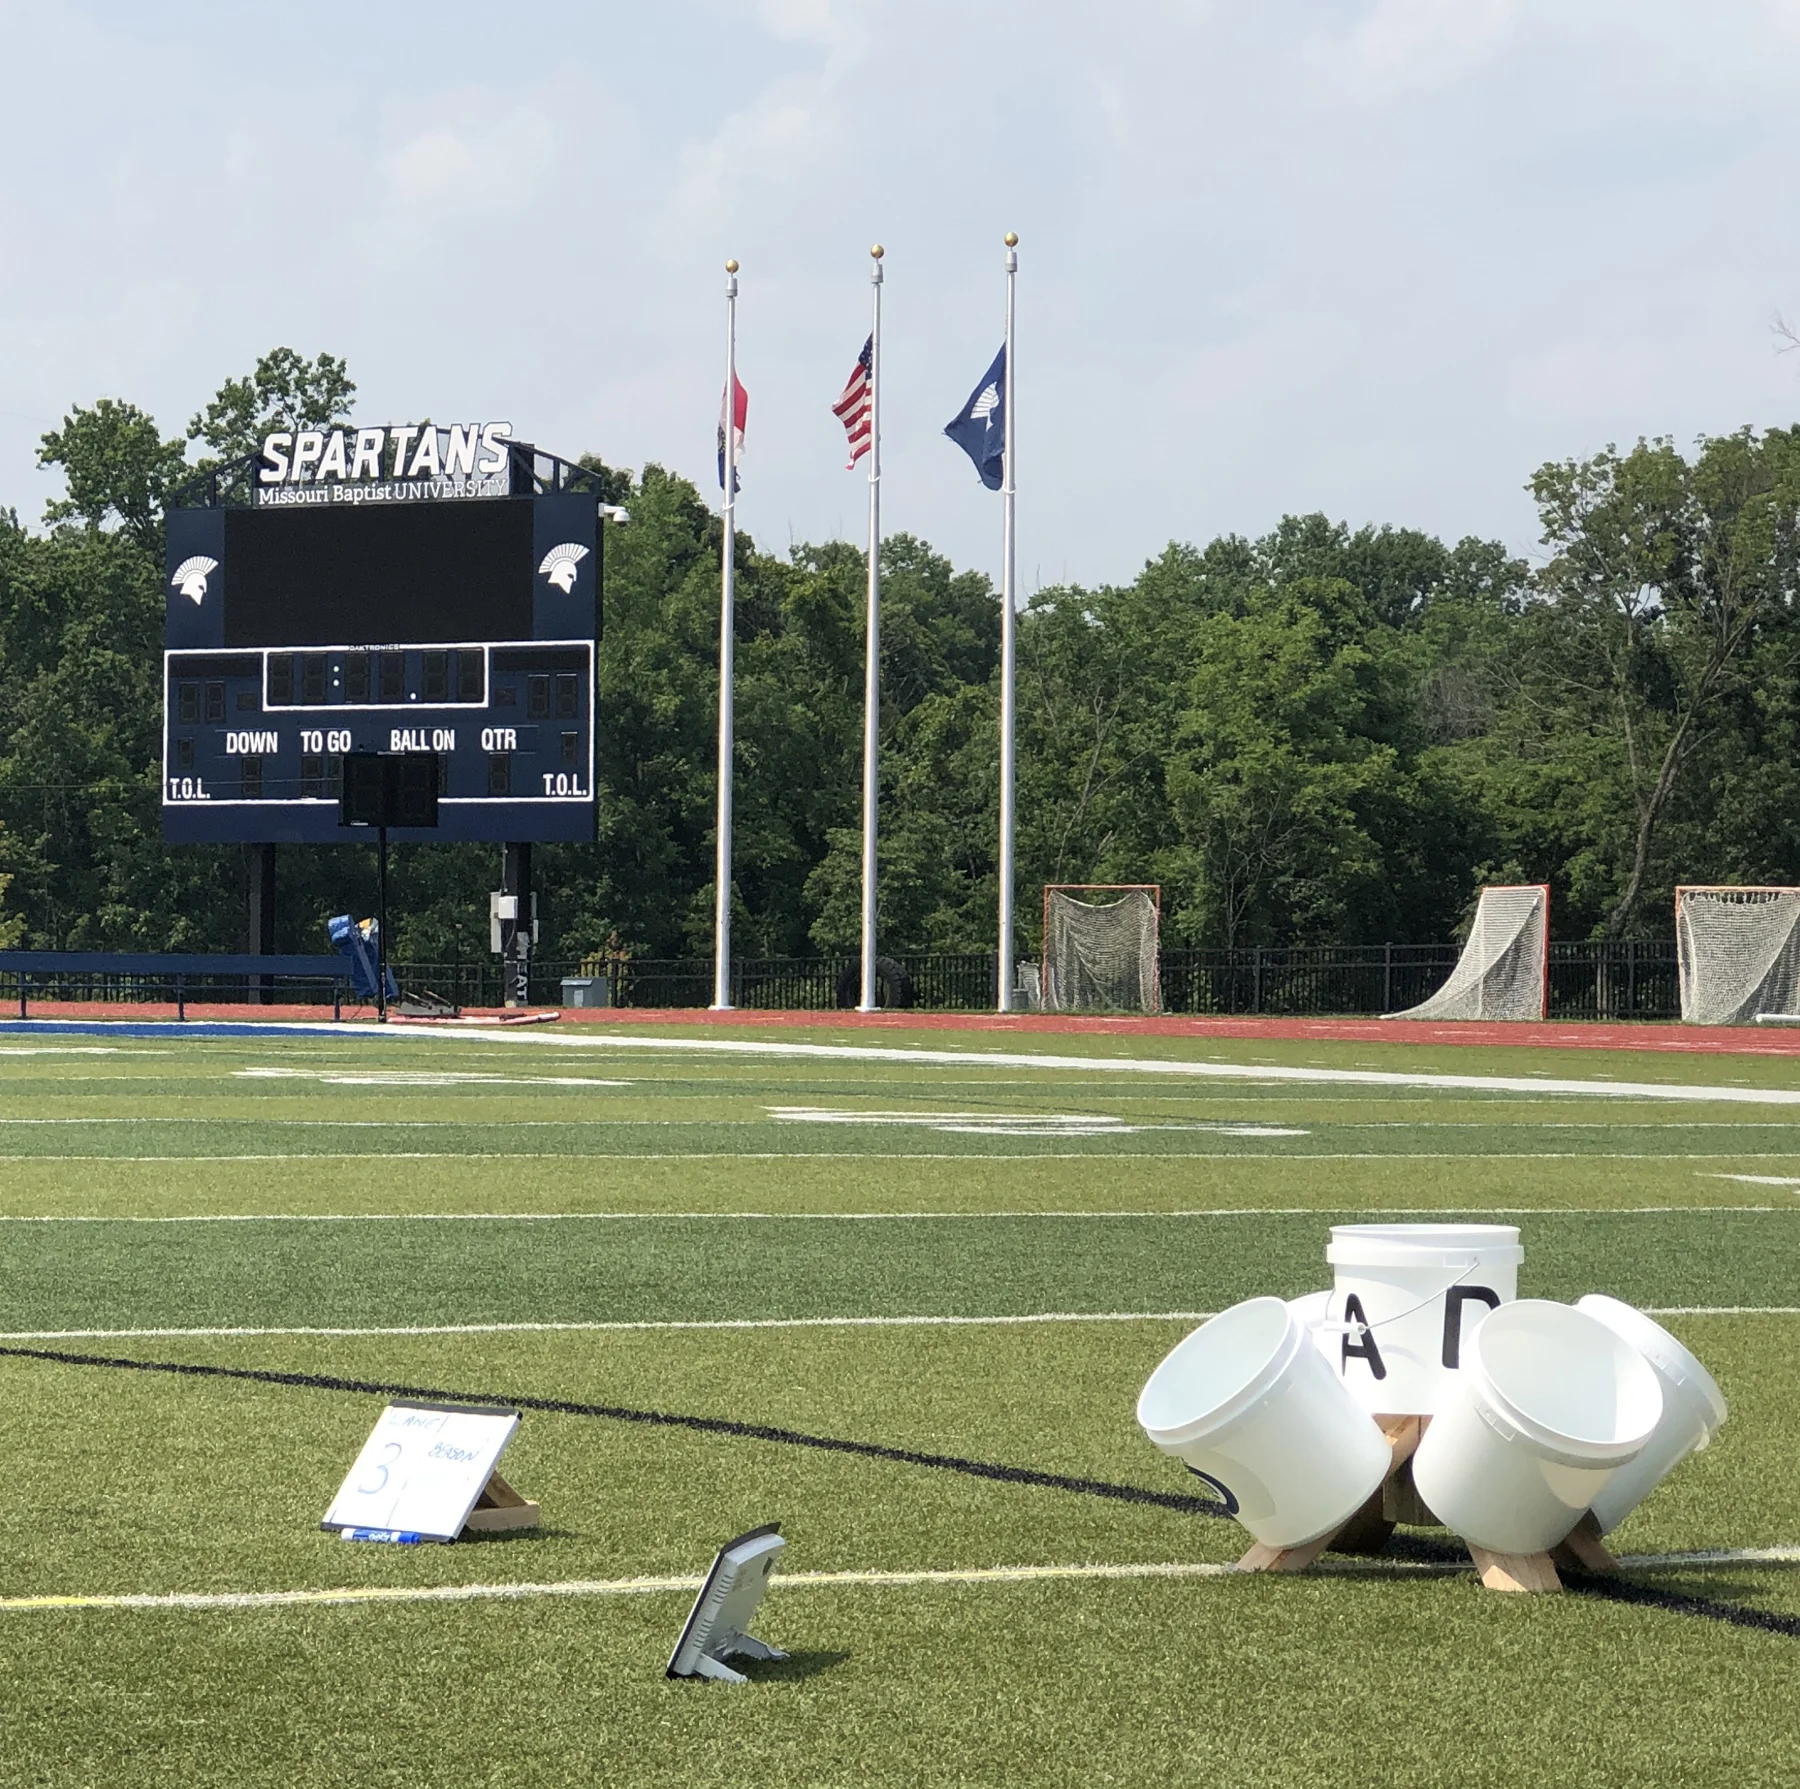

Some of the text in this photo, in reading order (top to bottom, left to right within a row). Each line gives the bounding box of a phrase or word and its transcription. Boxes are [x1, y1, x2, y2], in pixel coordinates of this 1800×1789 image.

[258, 421, 513, 482] SPARTANS
[259, 478, 507, 505] Missouri Baptist UNIVERSITY
[226, 731, 279, 754] DOWN
[300, 730, 352, 753] TO GO
[390, 728, 456, 751] BALL ON
[481, 728, 517, 750] QTR
[169, 777, 211, 800] T.O.L.
[542, 772, 588, 796] T.O.L.
[357, 1441, 403, 1495] 3
